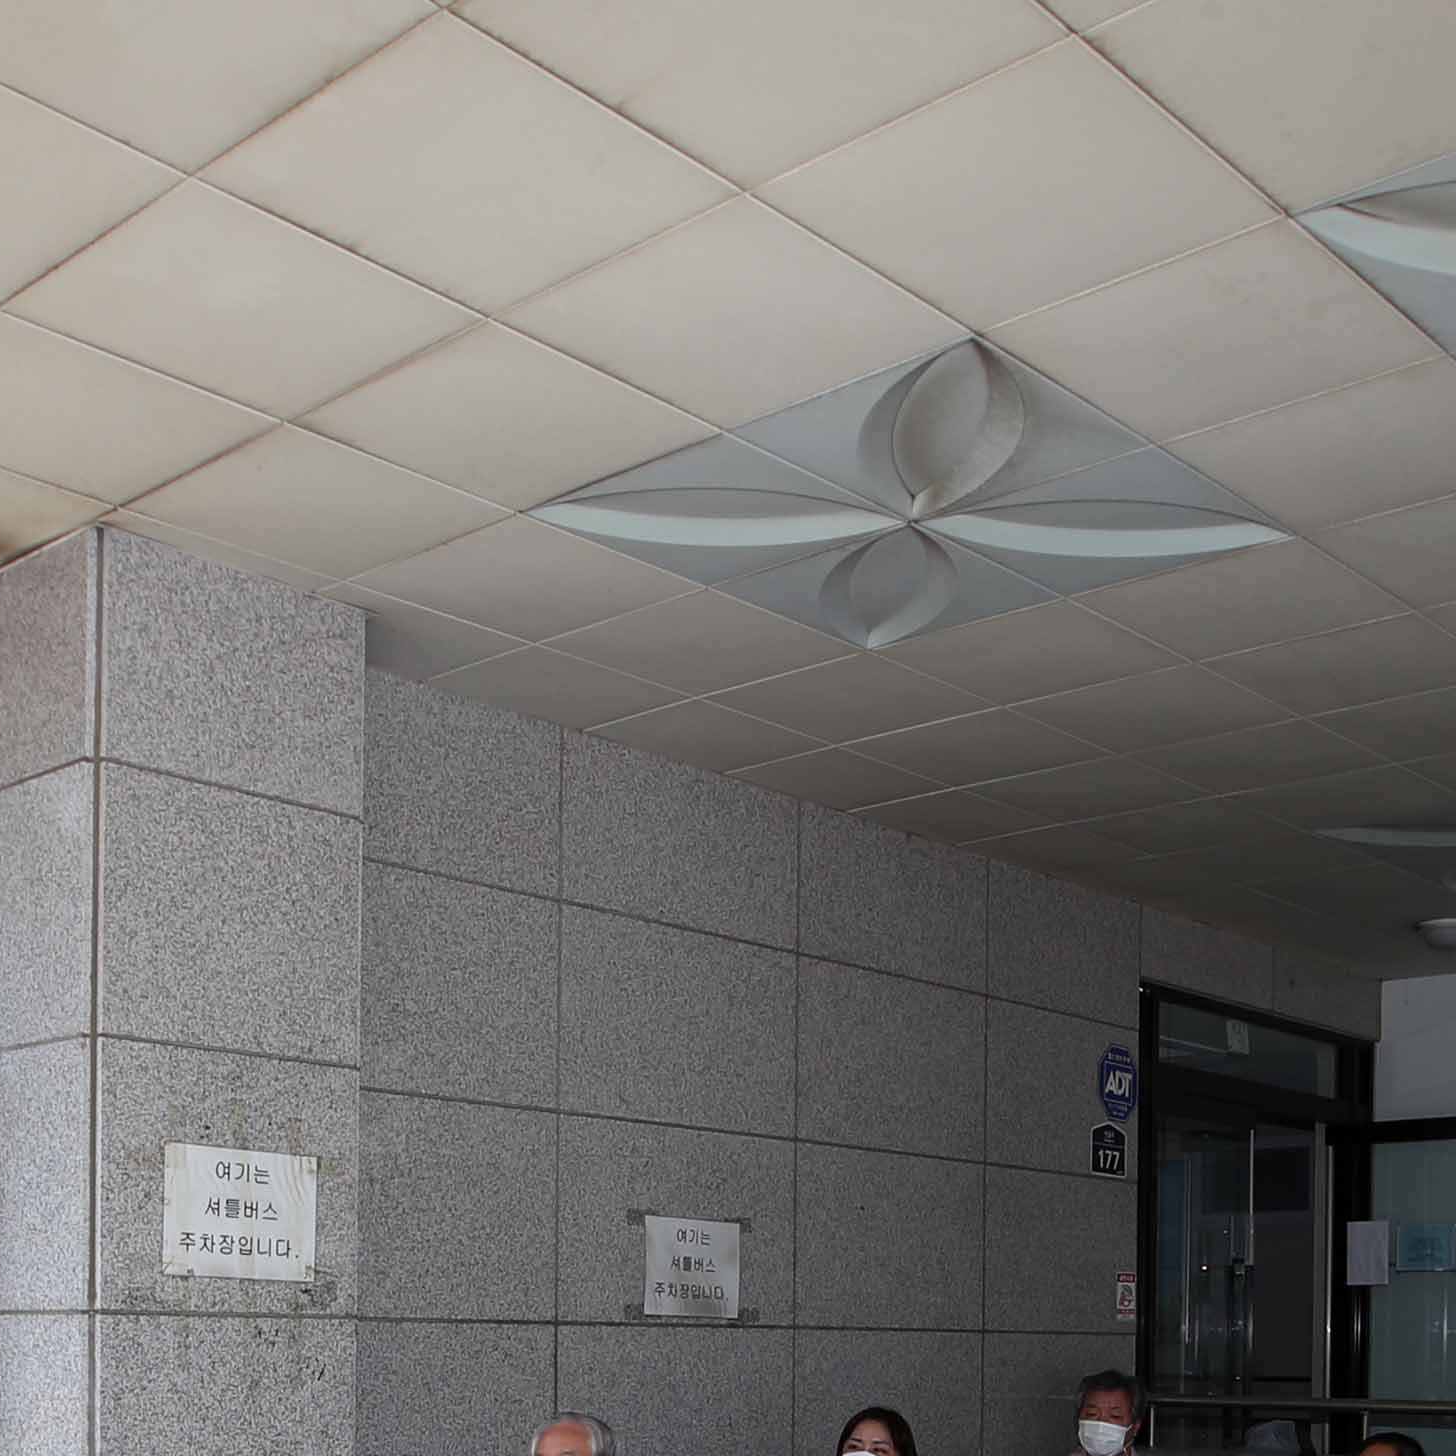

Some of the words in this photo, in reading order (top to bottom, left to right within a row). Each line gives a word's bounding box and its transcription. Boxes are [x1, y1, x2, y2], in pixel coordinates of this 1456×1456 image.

[1105, 1070, 1133, 1098] ADT
[1098, 1149, 1121, 1171] 177
[215, 1161, 270, 1185] 여기는
[204, 1197, 279, 1221] 셔틀버스
[178, 1232, 300, 1259] 주차장입니다.
[676, 1228, 712, 1246] 여기는
[670, 1256, 717, 1273] 셔틀버스
[654, 1282, 729, 1302] 주차장입니다.
